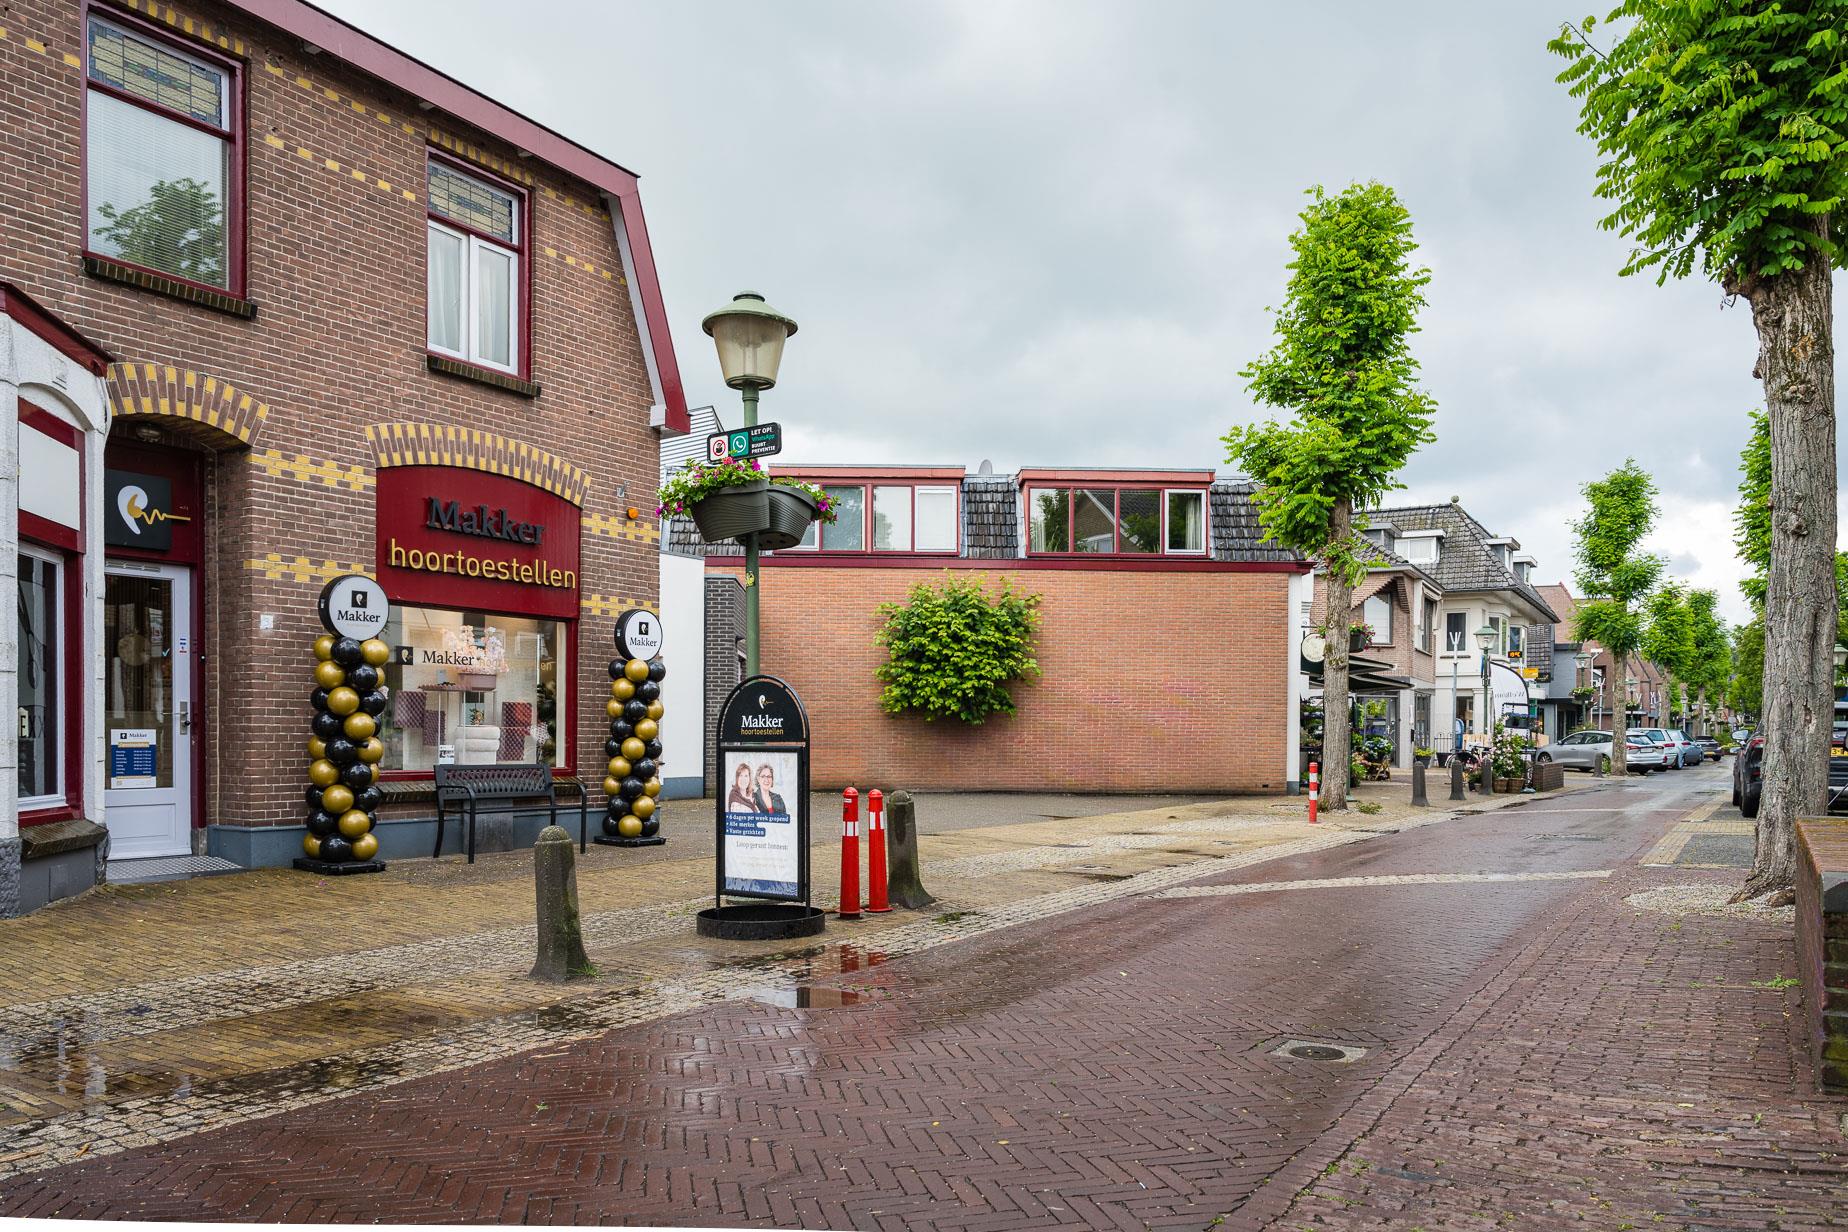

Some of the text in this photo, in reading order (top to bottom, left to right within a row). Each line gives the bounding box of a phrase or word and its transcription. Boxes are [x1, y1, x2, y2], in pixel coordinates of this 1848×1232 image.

[751, 446, 776, 454] PREVENTIE
[427, 496, 545, 545] Makker
[390, 538, 576, 589] hoortoestellen
[337, 610, 381, 623] Makker
[630, 637, 658, 647] Makker
[422, 650, 475, 666] Makker
[741, 714, 784, 728] Makker
